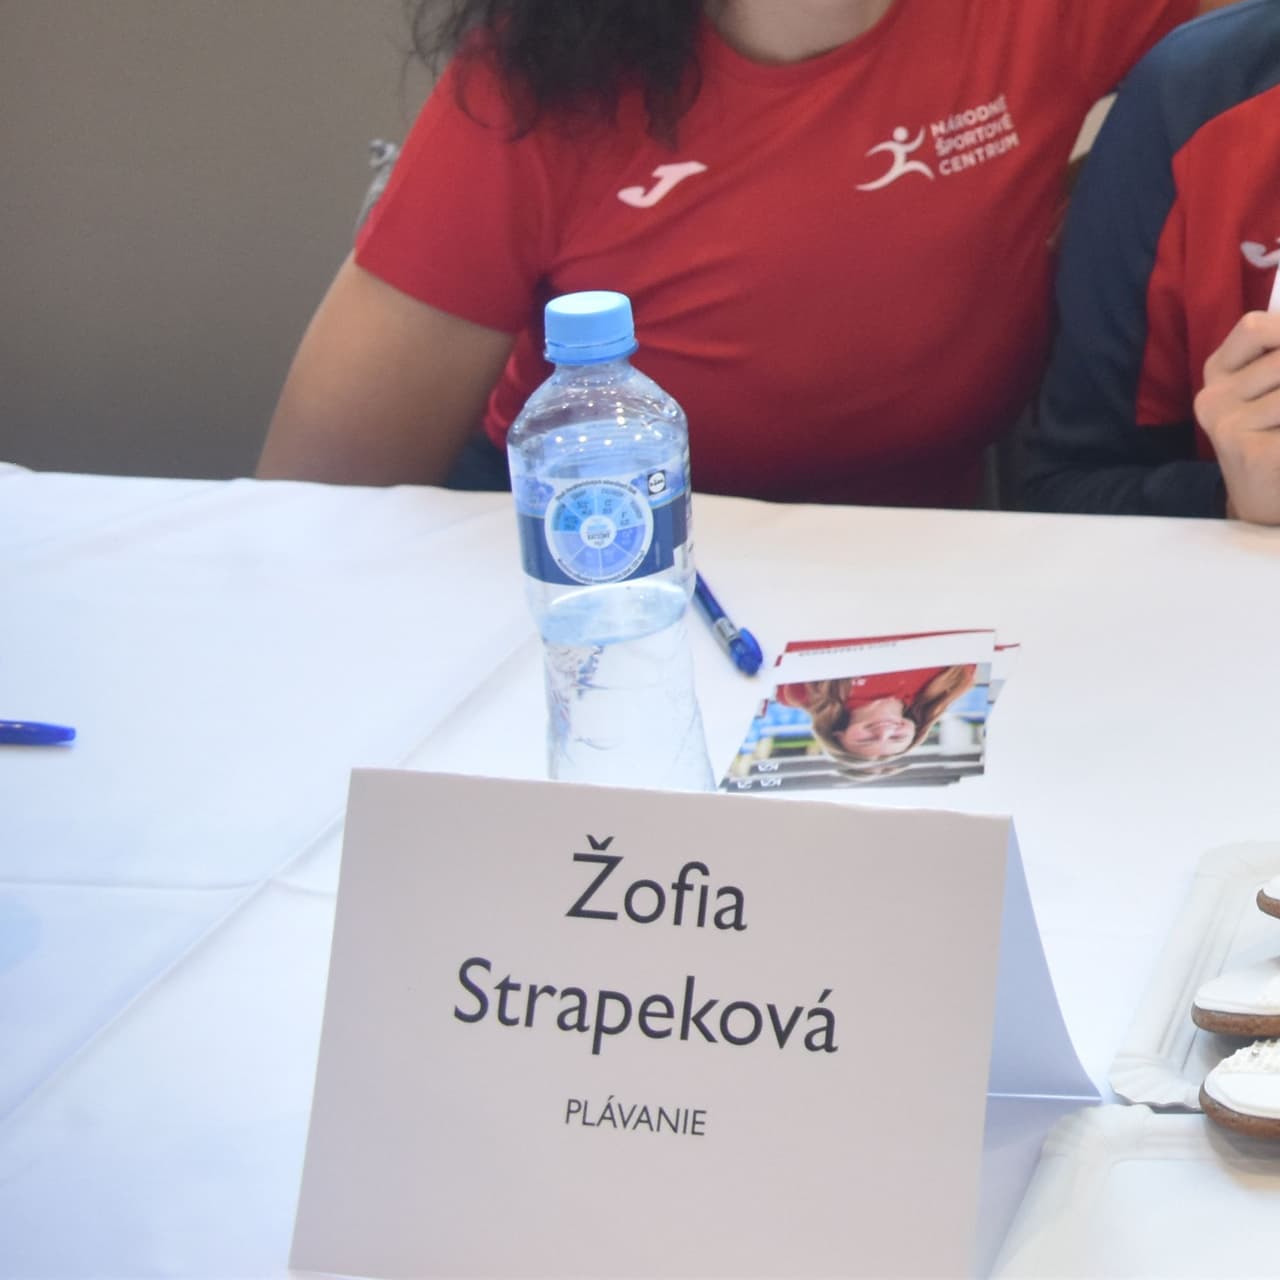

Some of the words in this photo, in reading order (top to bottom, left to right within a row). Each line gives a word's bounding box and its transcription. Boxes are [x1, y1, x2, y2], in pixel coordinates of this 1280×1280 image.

[939, 132, 1019, 175] CENTRUM
[565, 834, 748, 932] Žofia
[453, 956, 839, 1056] Strapeková
[565, 1094, 707, 1136] PLÁVANIE
